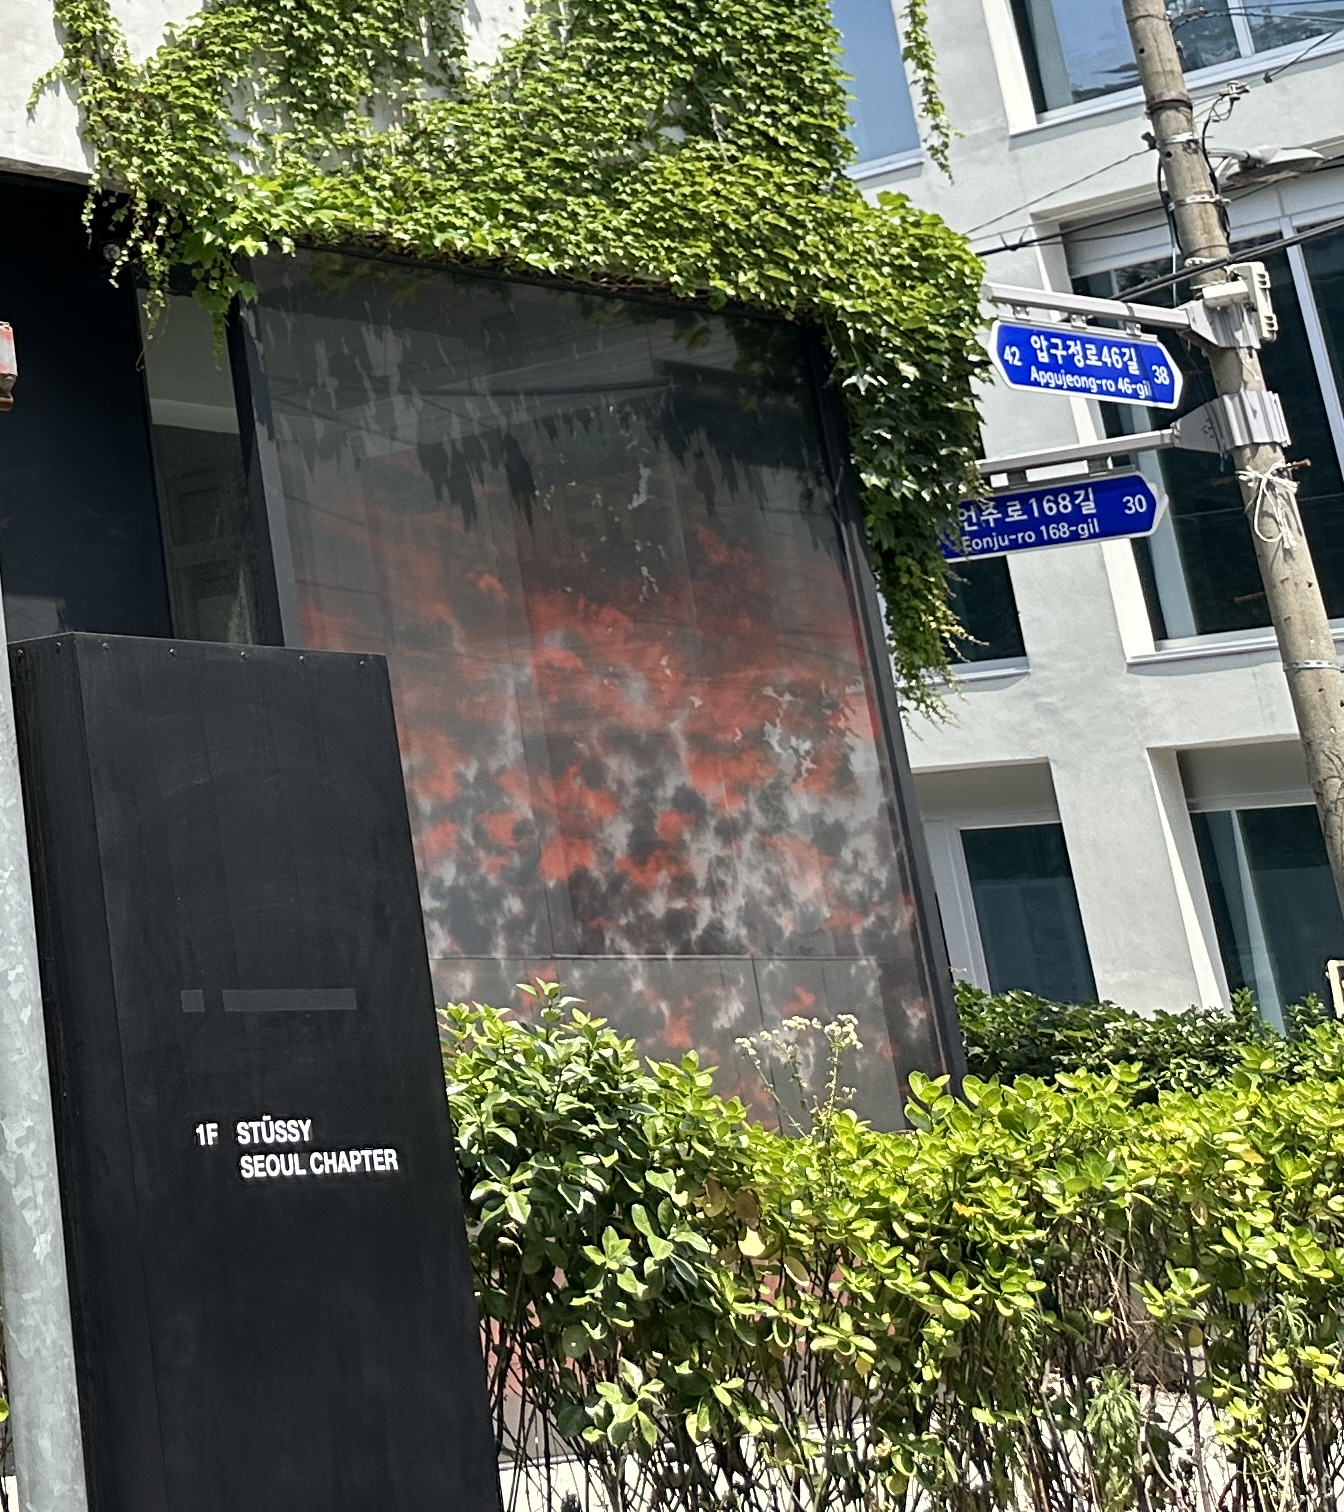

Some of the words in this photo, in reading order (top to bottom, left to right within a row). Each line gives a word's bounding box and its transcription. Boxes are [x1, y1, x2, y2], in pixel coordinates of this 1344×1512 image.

[1003, 345, 1022, 367] 42
[1030, 335, 1140, 375] 압구정로46길
[1030, 365, 1115, 394] Apgujeong-ro
[1117, 376, 1153, 399] 46-gil
[1151, 365, 1170, 385] 38
[958, 487, 1097, 532] 언주로168길
[1122, 494, 1148, 515] 30
[962, 528, 1036, 554] Eonju-ro
[1040, 517, 1100, 541] 168-gil
[196, 1122, 219, 1146] 1F
[236, 1115, 312, 1145] STÜSSY
[240, 1153, 307, 1179] SEOUL
[309, 1148, 399, 1175] CHAPTER
